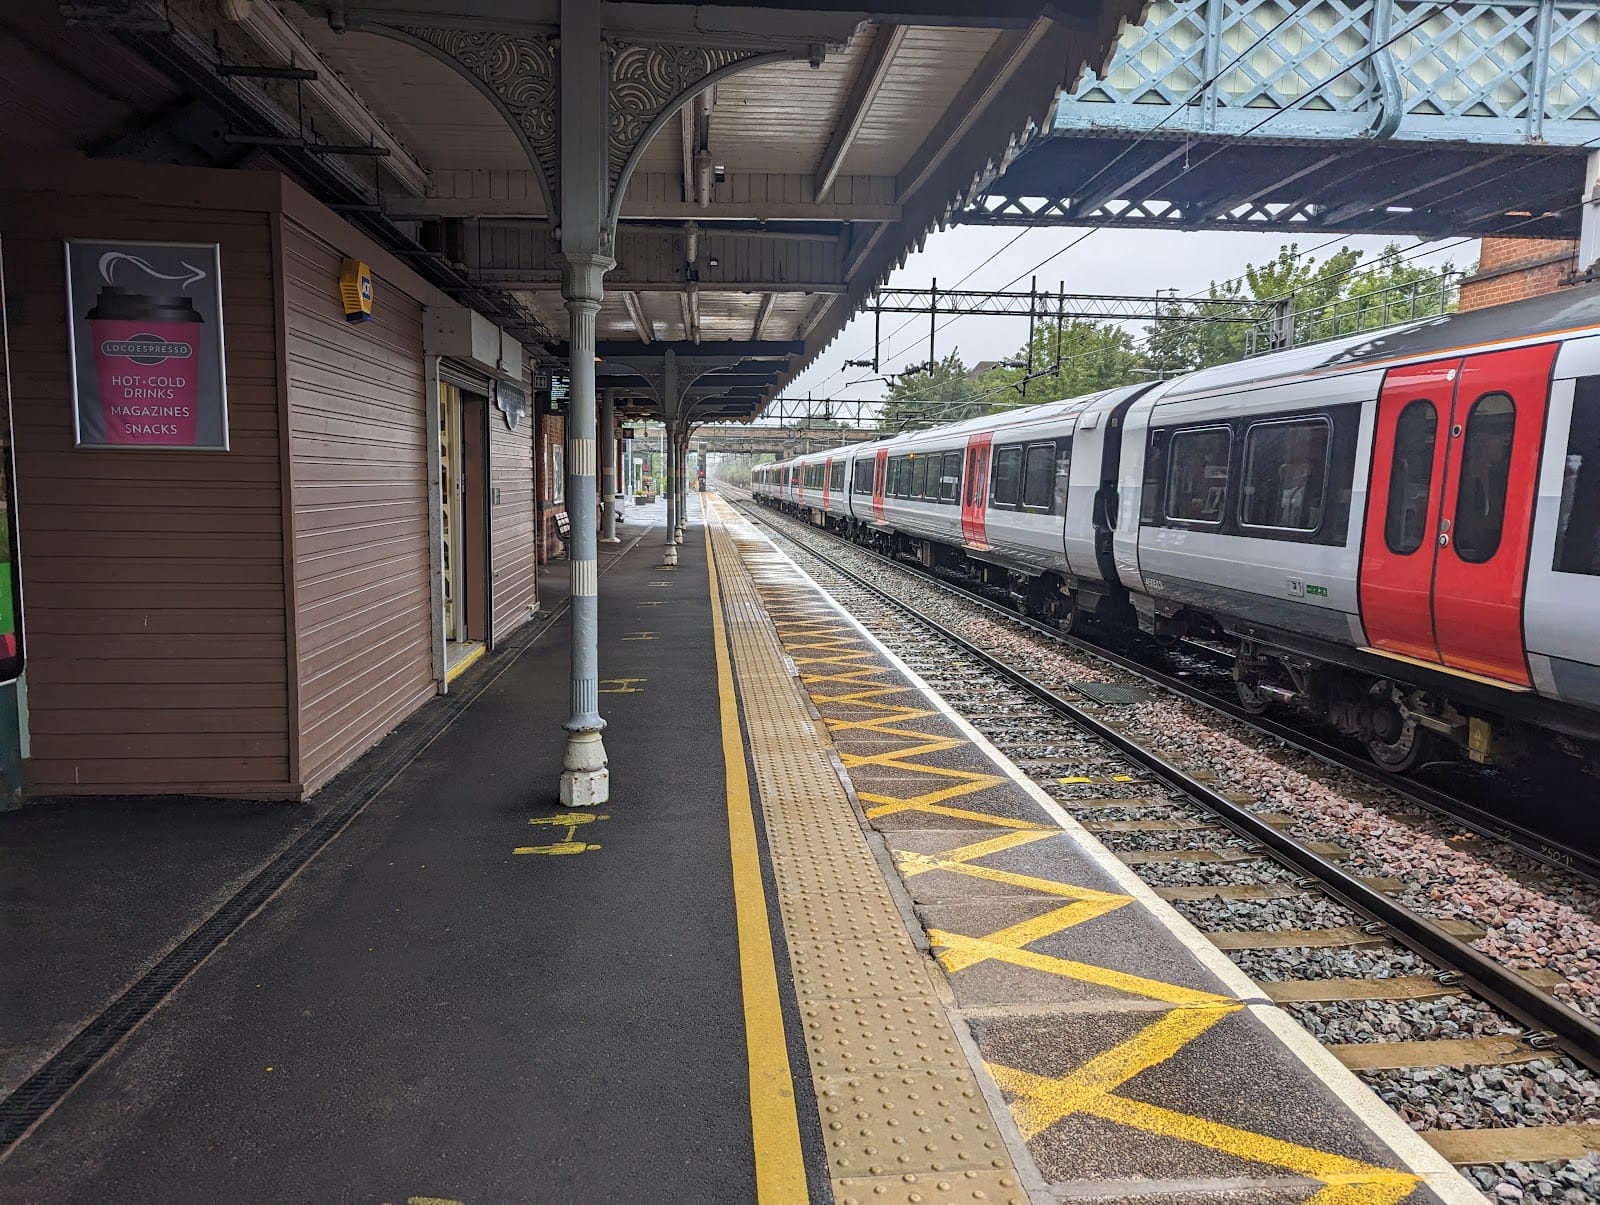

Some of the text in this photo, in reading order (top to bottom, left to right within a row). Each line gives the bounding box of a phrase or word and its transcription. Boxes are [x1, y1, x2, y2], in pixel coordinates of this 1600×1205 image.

[106, 344, 188, 354] LOCOESPRESSO
[124, 388, 174, 399] DRINKS
[111, 405, 190, 417] MAGAZINES
[125, 423, 177, 435] SNACKS
